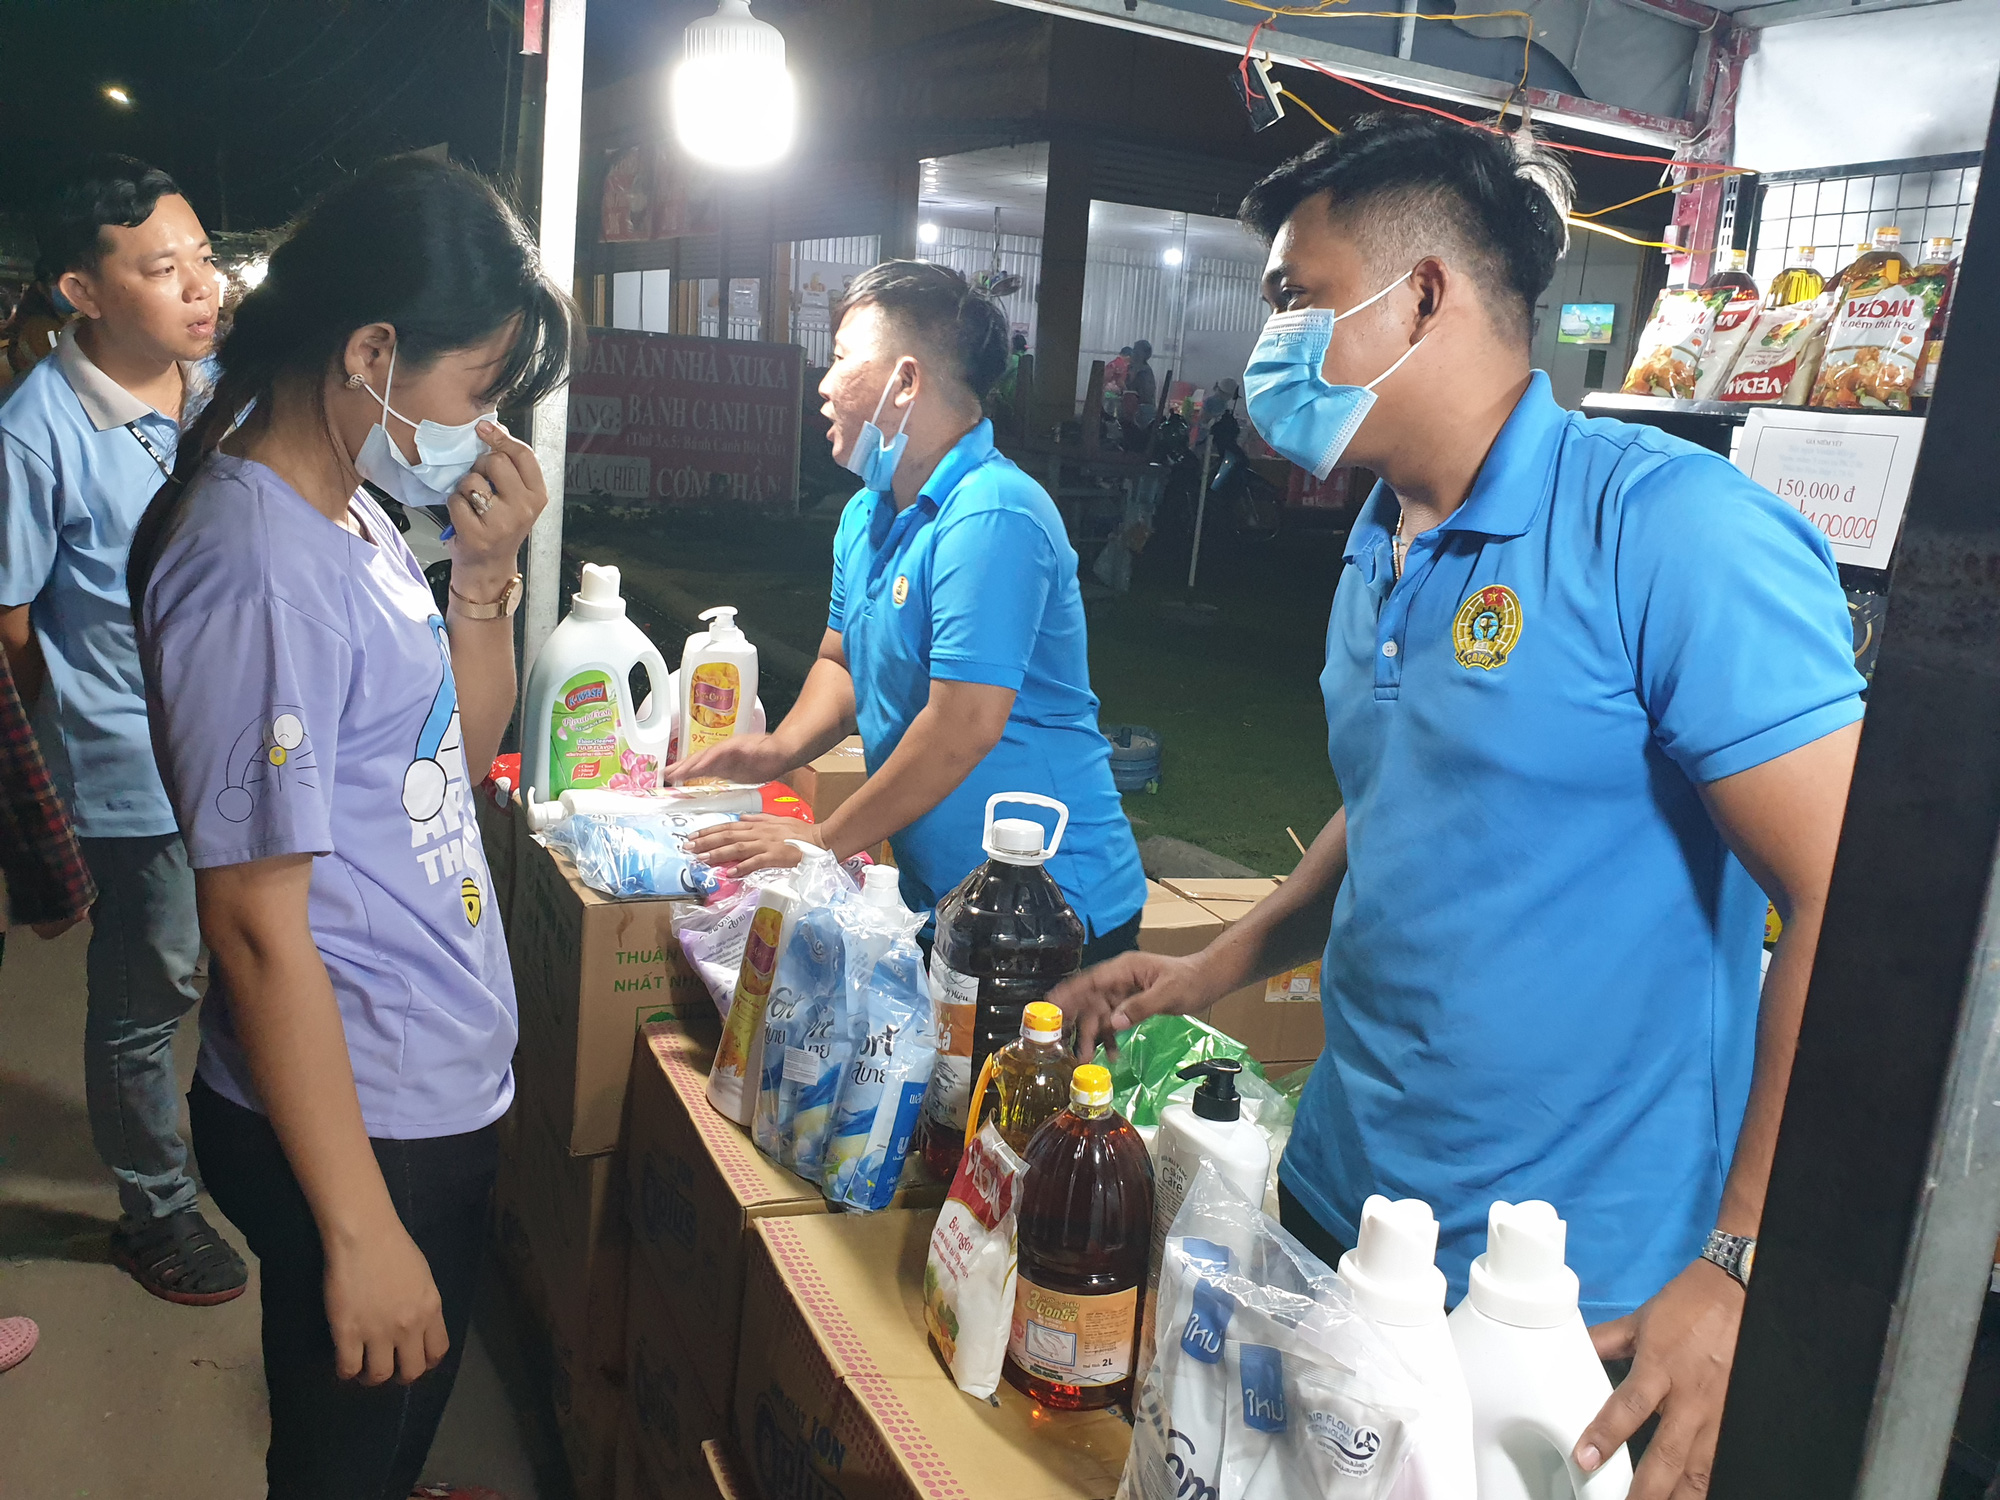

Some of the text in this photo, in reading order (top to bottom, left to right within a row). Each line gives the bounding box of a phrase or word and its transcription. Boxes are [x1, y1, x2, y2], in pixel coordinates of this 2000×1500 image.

[1848, 299, 1915, 318] VEDAN
[728, 354, 788, 390] XUKA
[1776, 478, 1840, 501] 150.000
[567, 687, 604, 706] K-WASH
[614, 971, 665, 992] NHẤT
[1162, 1167, 1183, 1194] Care
[1102, 1357, 1114, 1368] 2L
[1326, 1414, 1354, 1436] FLOW
